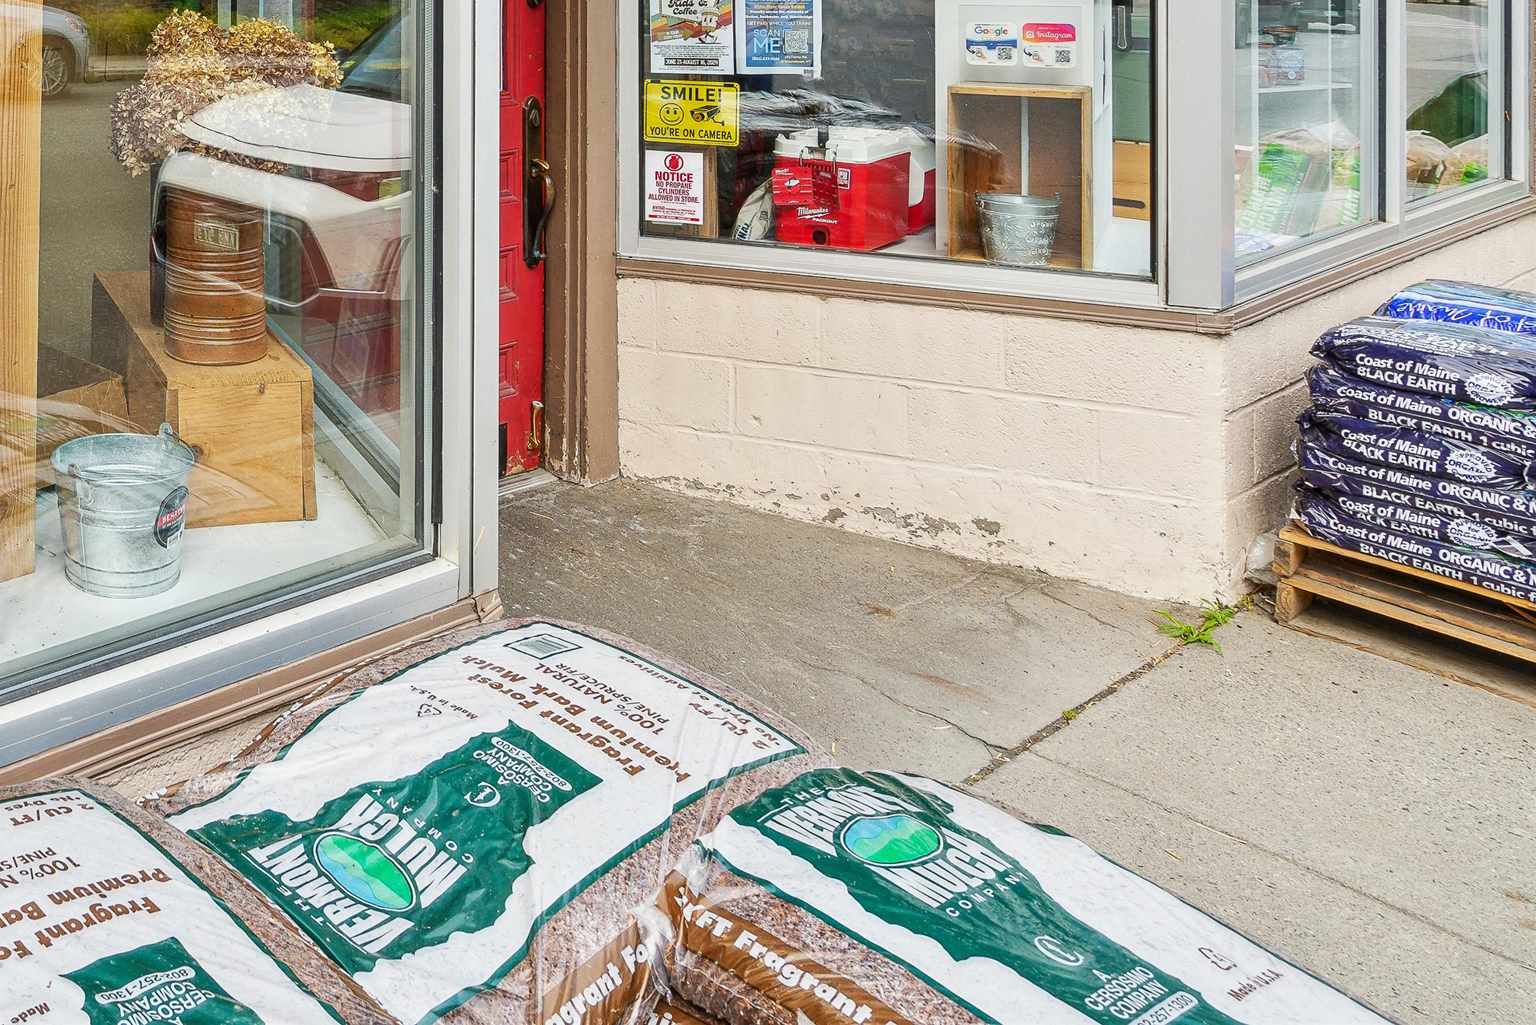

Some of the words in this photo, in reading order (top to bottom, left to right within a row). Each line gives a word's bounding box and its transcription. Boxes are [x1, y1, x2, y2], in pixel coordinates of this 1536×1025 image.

[753, 38, 780, 53] ME
[974, 27, 1008, 36] Google
[1037, 31, 1072, 40] Instagram
[661, 86, 721, 102] SMILE!
[650, 126, 680, 137] YOU'RE
[683, 128, 695, 138] ON
[698, 129, 732, 140] CAMERA
[655, 171, 693, 182] NOTICE
[648, 194, 674, 202] ALLOWED
[1356, 353, 1392, 369] Coast
[1395, 360, 1412, 373] of
[1414, 363, 1459, 381] Maine
[1357, 367, 1403, 387] BLACK
[1406, 375, 1456, 395] EARTH
[1336, 386, 1376, 406] Coast
[1377, 394, 1393, 409] of
[1395, 396, 1442, 416] Maine
[1448, 407, 1521, 435] ORGANIC
[1340, 428, 1376, 445] Coast
[1376, 434, 1392, 449] of
[1395, 437, 1441, 460] Maine
[1368, 409, 1415, 430] BLACK
[1422, 422, 1472, 442] EARTH
[1479, 436, 1489, 447] 1
[1491, 438, 1535, 457] cubic
[1388, 451, 1437, 472] EARTH
[1327, 457, 1368, 476] Coast
[1369, 466, 1384, 480] of
[1386, 469, 1432, 490] Maine
[1438, 482, 1510, 508] ORGANIC
[1513, 497, 1528, 512] &
[1338, 497, 1375, 515] Coast
[1377, 505, 1394, 519] of
[1395, 506, 1441, 527] Maine
[1362, 485, 1411, 505] BLACK
[1415, 495, 1464, 517] EARTH
[1472, 513, 1480, 522] 1
[1484, 515, 1528, 534] cubic
[1390, 518, 1439, 540] EARTH
[1329, 519, 1368, 539] Coast
[1369, 531, 1384, 546] of
[1386, 534, 1432, 556] Maine
[1439, 549, 1512, 578] ORGANIC
[1513, 569, 1528, 584] &
[1359, 543, 1408, 566] BLACK
[1413, 558, 1463, 580] EARTH
[1470, 576, 1478, 586] 1
[1482, 580, 1525, 599] cubic
[462, 655, 526, 684] Mulch
[534, 662, 612, 705] NATURAL
[468, 673, 539, 710] Forest
[529, 683, 586, 716] Bark
[555, 663, 669, 724] PINE/SPRUCE/FIR
[614, 707, 665, 735] 100%
[540, 710, 645, 776] Fragrant
[590, 715, 690, 783] Premium
[473, 750, 550, 803] CERSOSIMO
[486, 747, 552, 792] COMPANY
[497, 775, 511, 786] A
[78, 803, 95, 811] 2
[780, 787, 822, 806] THE
[10, 806, 73, 827] CU/FT
[371, 786, 474, 863] COMPANY
[764, 784, 923, 857] VERMONT
[328, 793, 468, 908] MULCH
[20, 857, 81, 880] 100%
[867, 827, 1014, 909] MULCH
[48, 867, 172, 905] Premium
[247, 833, 415, 954] VERMONT
[946, 872, 1031, 917] COMPANY
[276, 884, 324, 926] THE
[34, 897, 161, 948] Fragrant
[101, 968, 189, 1002] 802-257-1300
[733, 930, 873, 1025] Fragrant
[1085, 966, 1154, 1011] CERSOSIMO
[1092, 969, 1110, 981] A
[1227, 982, 1257, 1002] Made
[10, 1002, 50, 1024] Made
[118, 982, 196, 1016] COMPANY
[1109, 980, 1169, 1019] COMPANY
